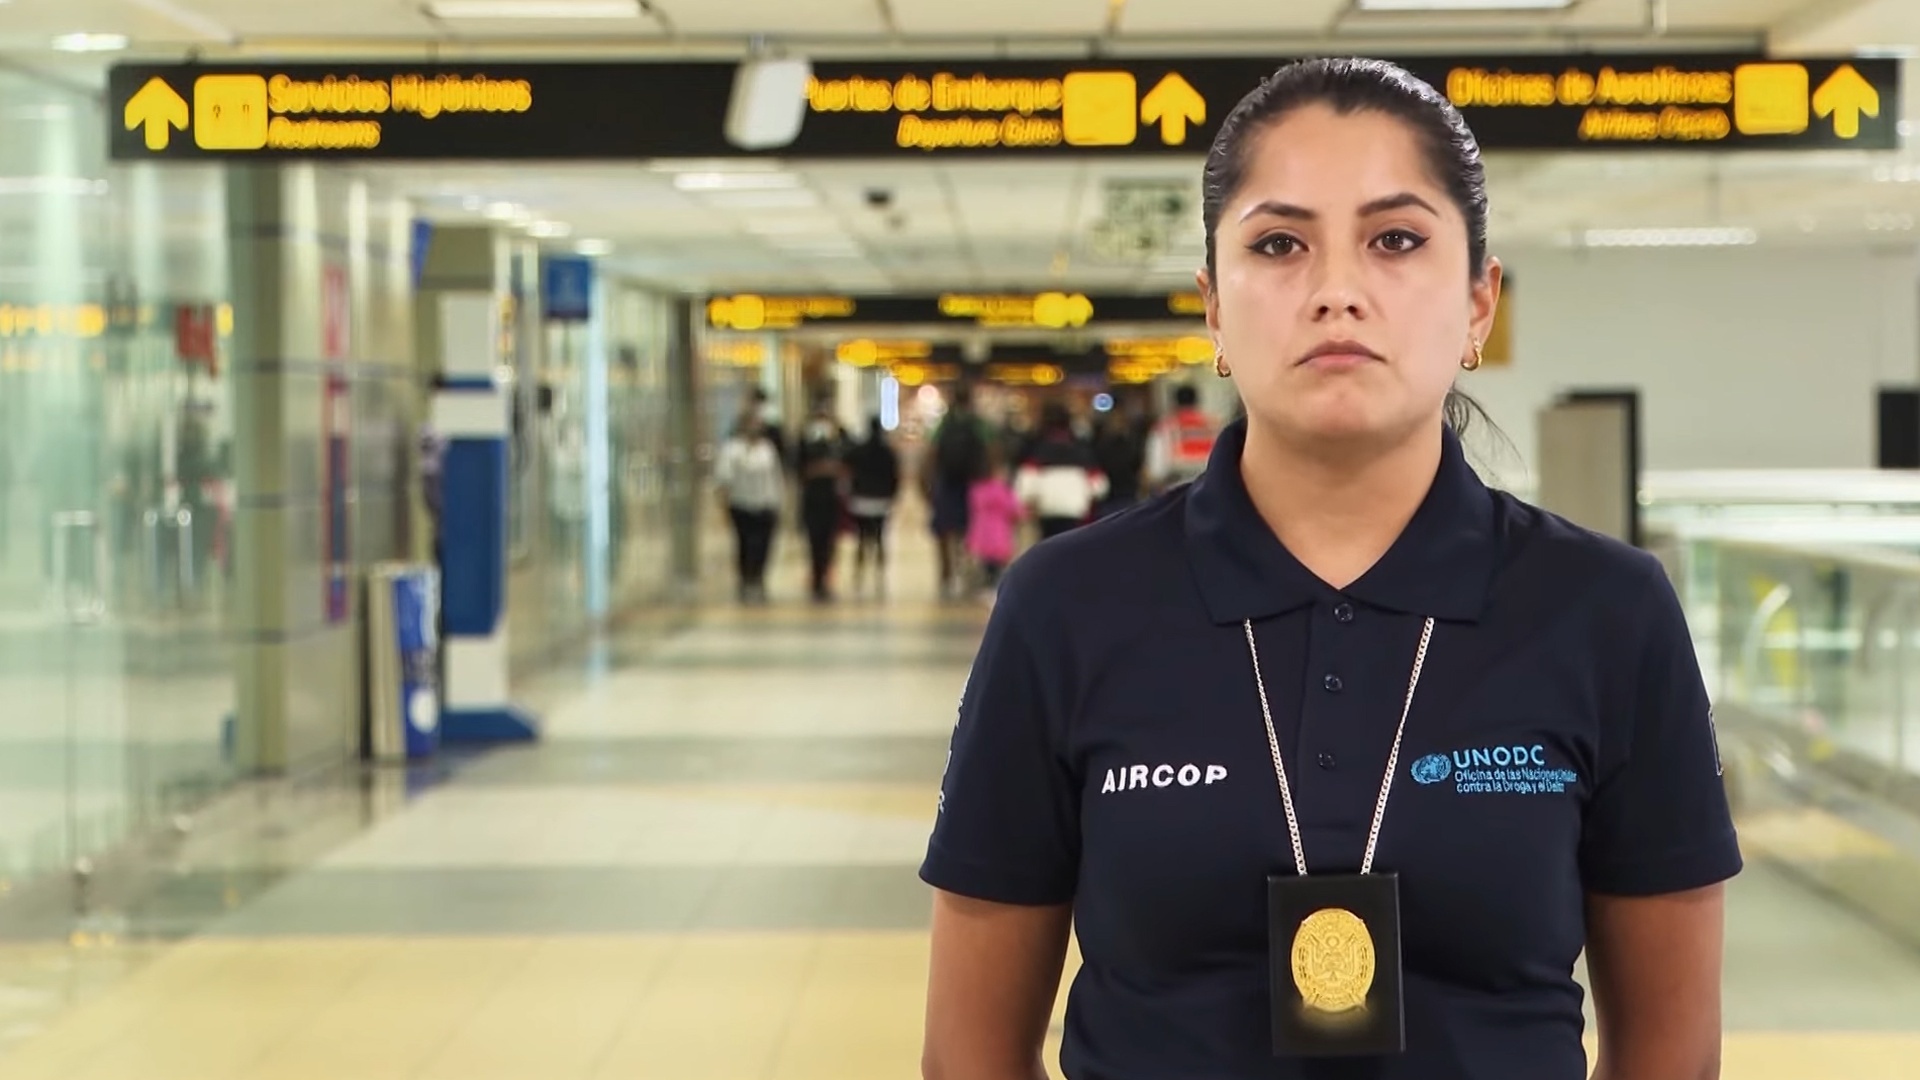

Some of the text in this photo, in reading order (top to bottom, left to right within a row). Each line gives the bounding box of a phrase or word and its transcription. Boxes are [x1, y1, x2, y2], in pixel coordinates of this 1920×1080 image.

[1453, 745, 1545, 769] UNODC
[1101, 763, 1228, 794] AIRCOP
[1455, 768, 1493, 782] Oficina
[1494, 767, 1506, 780] de
[1507, 768, 1521, 780] las
[1456, 781, 1492, 793] contra
[1492, 780, 1503, 793] la
[1503, 779, 1532, 794] Droga
